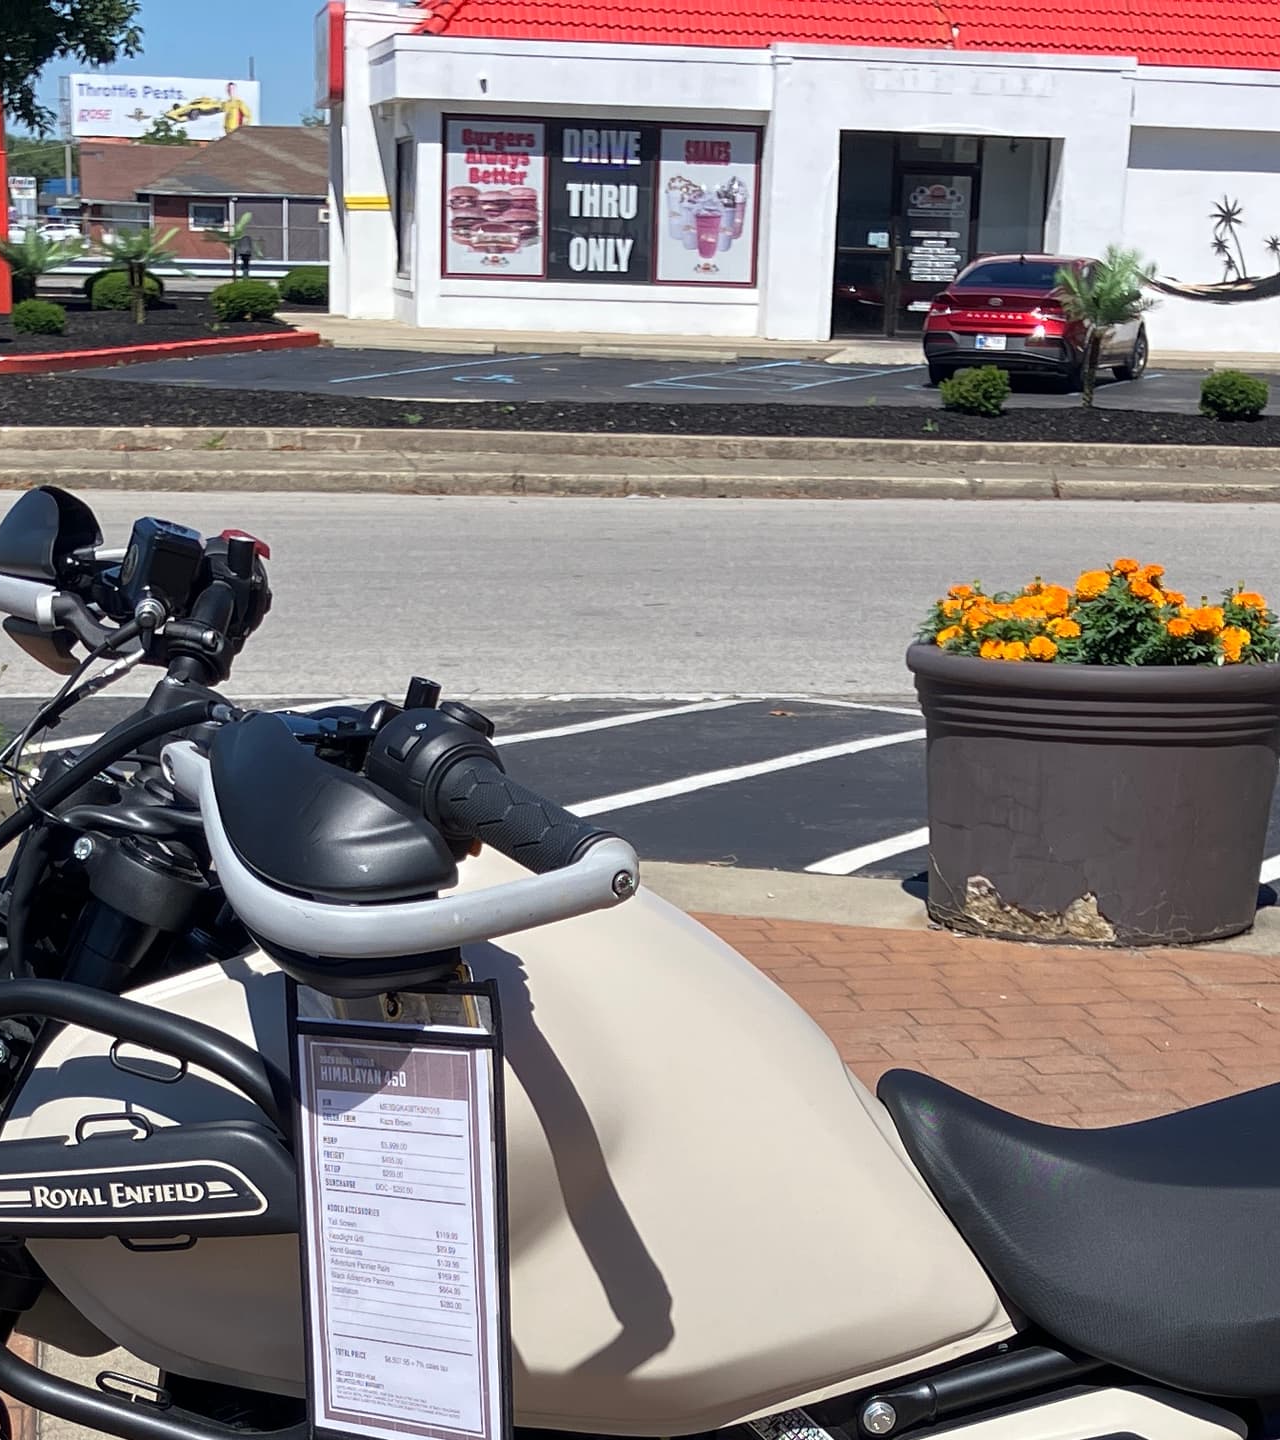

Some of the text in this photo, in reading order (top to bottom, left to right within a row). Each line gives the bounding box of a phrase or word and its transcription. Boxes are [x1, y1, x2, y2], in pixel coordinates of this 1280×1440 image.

[77, 83, 138, 99] Throttle
[461, 128, 535, 148] Burgers
[562, 128, 642, 165] DRIVE
[465, 148, 530, 168] Always
[469, 167, 528, 184] Better
[566, 182, 638, 220] THRU
[569, 236, 634, 273] ONLY
[320, 1065, 407, 1087] HIMALAYAN 450
[34, 1182, 205, 1209] ROYAL ENFIELD
